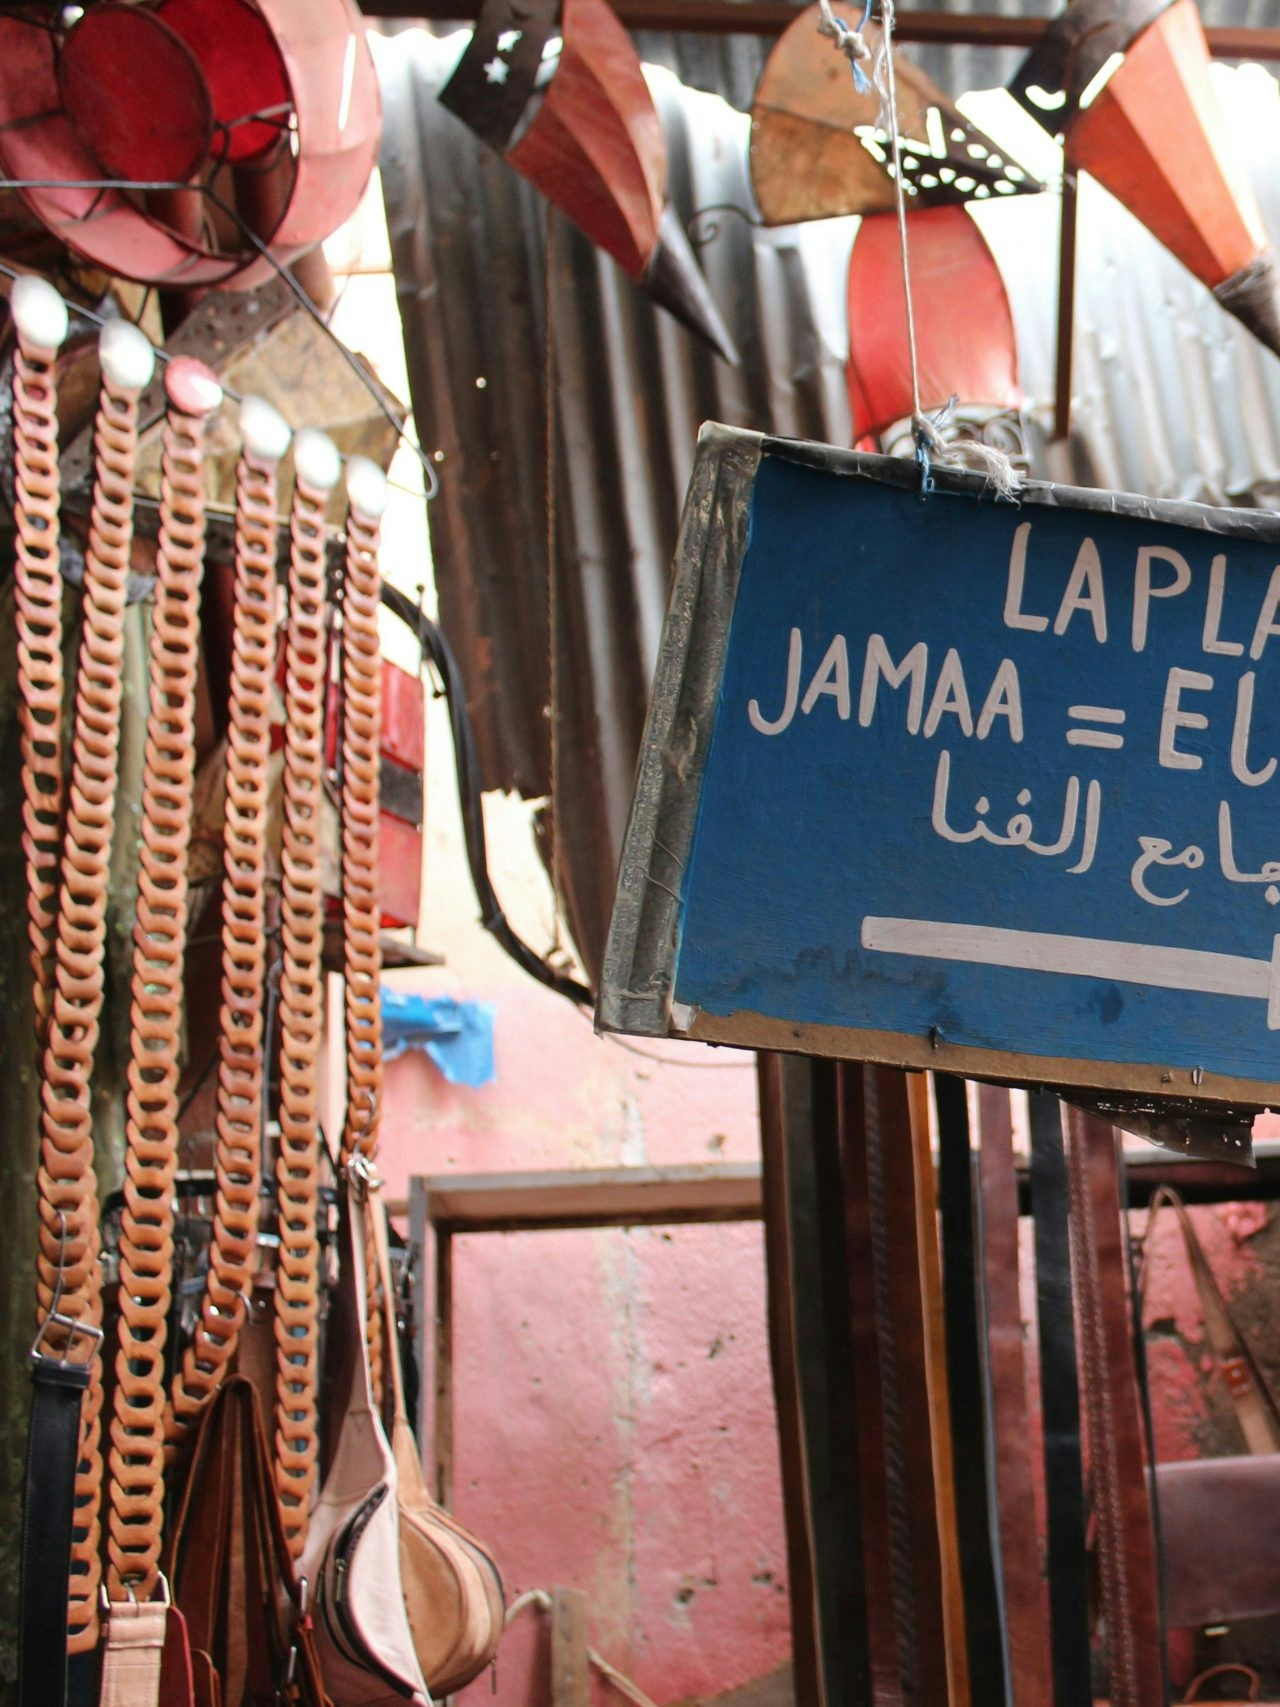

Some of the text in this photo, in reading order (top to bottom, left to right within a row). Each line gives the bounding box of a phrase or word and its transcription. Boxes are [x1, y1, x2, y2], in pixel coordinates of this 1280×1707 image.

[1003, 521, 1108, 644] LA
[748, 626, 1024, 744] JAMAA
[931, 749, 1101, 874] الفنا
